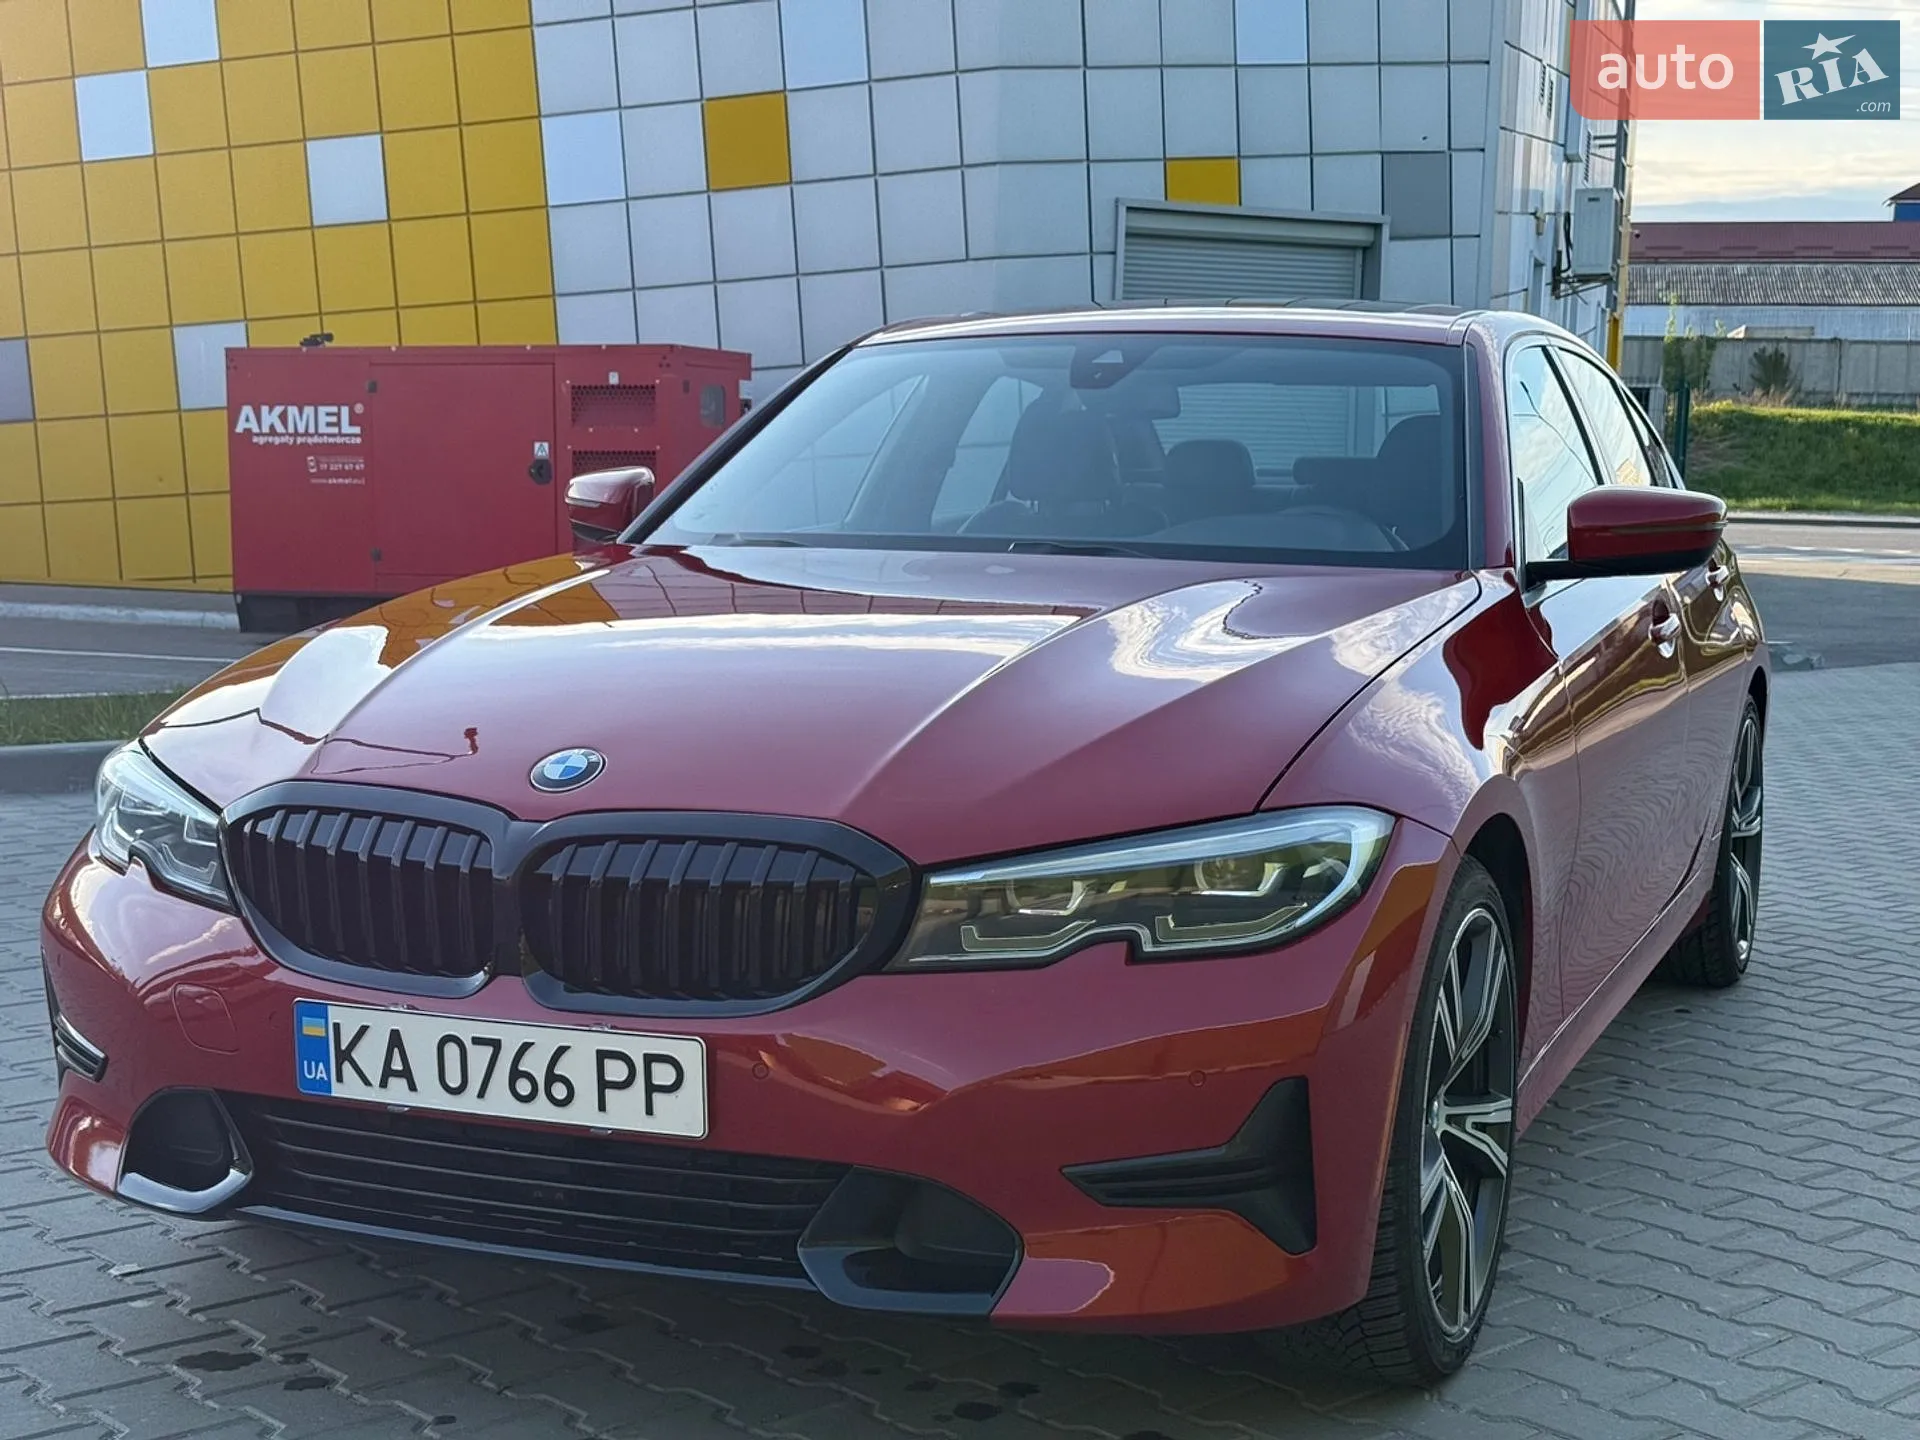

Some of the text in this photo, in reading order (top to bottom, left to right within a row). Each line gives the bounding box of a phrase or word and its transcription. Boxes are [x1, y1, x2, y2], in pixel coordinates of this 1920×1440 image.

[235, 404, 361, 435] AKMEL
[303, 1060, 328, 1081] UA
[332, 1021, 685, 1117] KA 0766 PP
